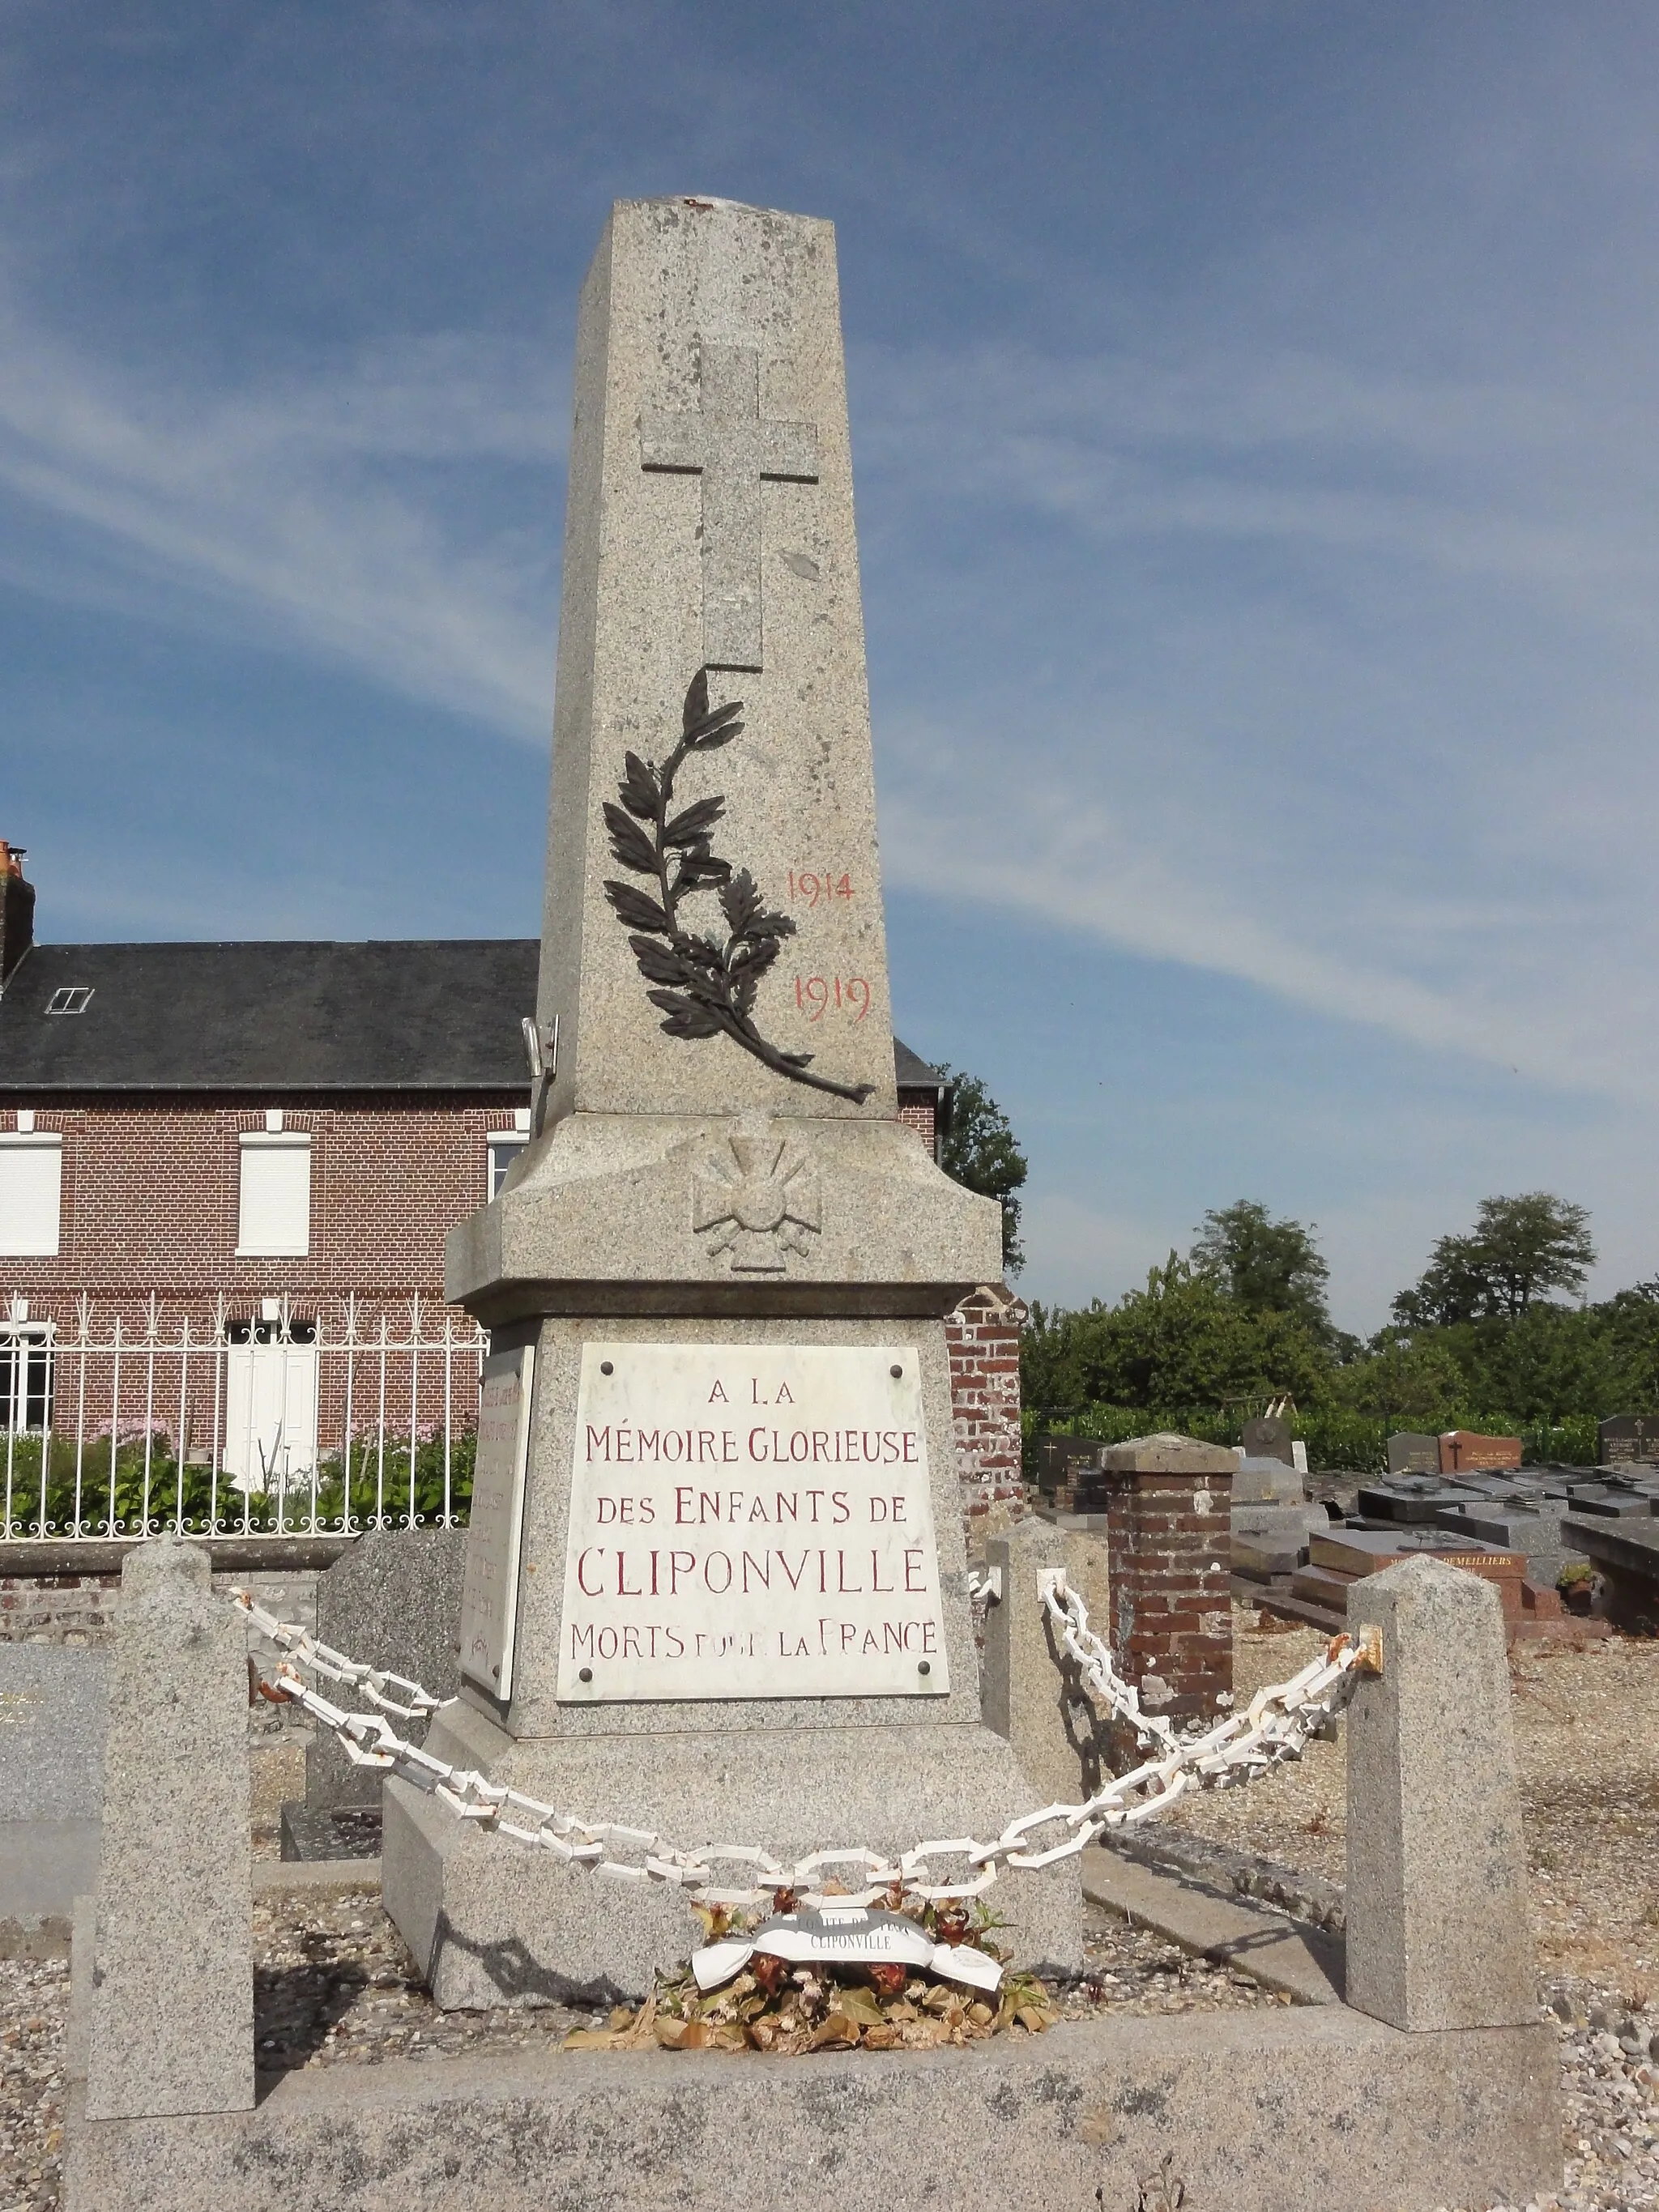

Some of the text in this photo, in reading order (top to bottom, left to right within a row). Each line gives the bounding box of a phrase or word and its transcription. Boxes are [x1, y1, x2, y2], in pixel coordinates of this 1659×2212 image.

[787, 870, 855, 908] 1914
[795, 974, 871, 1024] 1919
[707, 1376, 795, 1405] A LA
[585, 1417, 919, 1465] MÉMOIRE GLORIEUSE
[595, 1485, 907, 1525] DES ENFANTS DE
[577, 1546, 928, 1597] CLIPONVILLE
[570, 1622, 684, 1660] MORTS
[778, 1631, 811, 1657] LA
[818, 1617, 937, 1656] FRANCE
[811, 1935, 891, 1950] CLIPONVILLE
